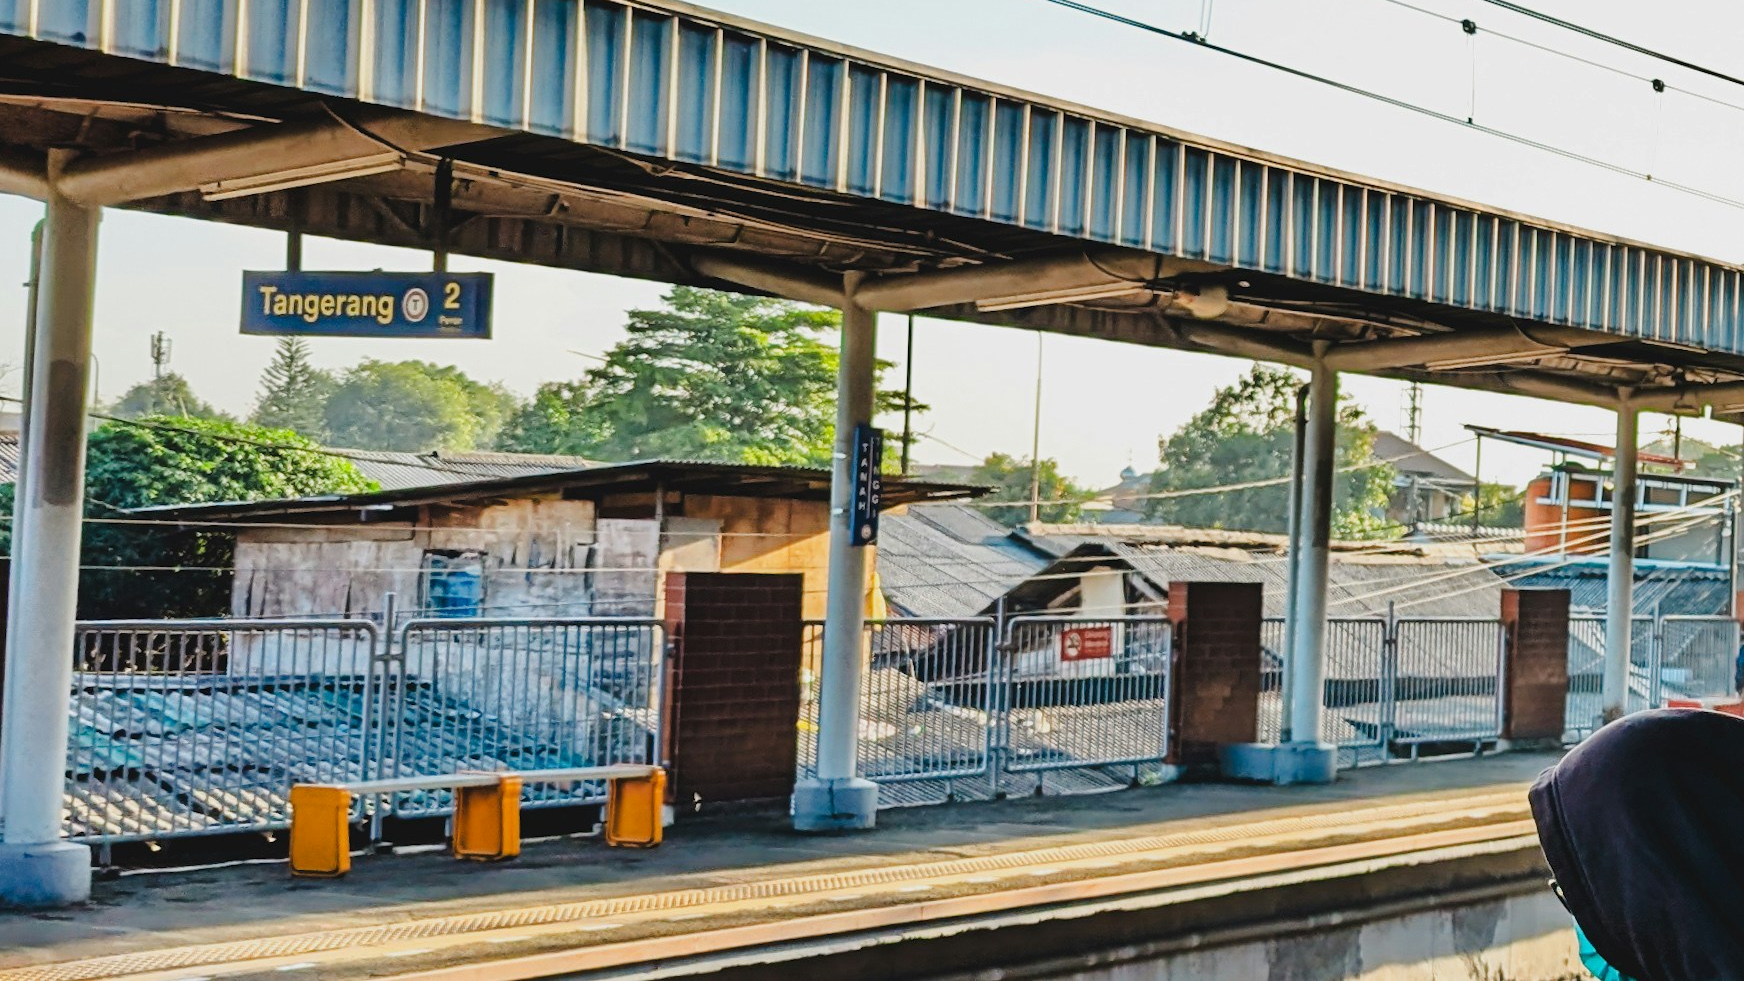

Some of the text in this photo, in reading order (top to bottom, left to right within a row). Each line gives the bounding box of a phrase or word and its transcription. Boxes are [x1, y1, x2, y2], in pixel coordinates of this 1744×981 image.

[259, 285, 395, 325] Tangerang
[444, 282, 461, 309] 2
[858, 443, 869, 511] TANAH
